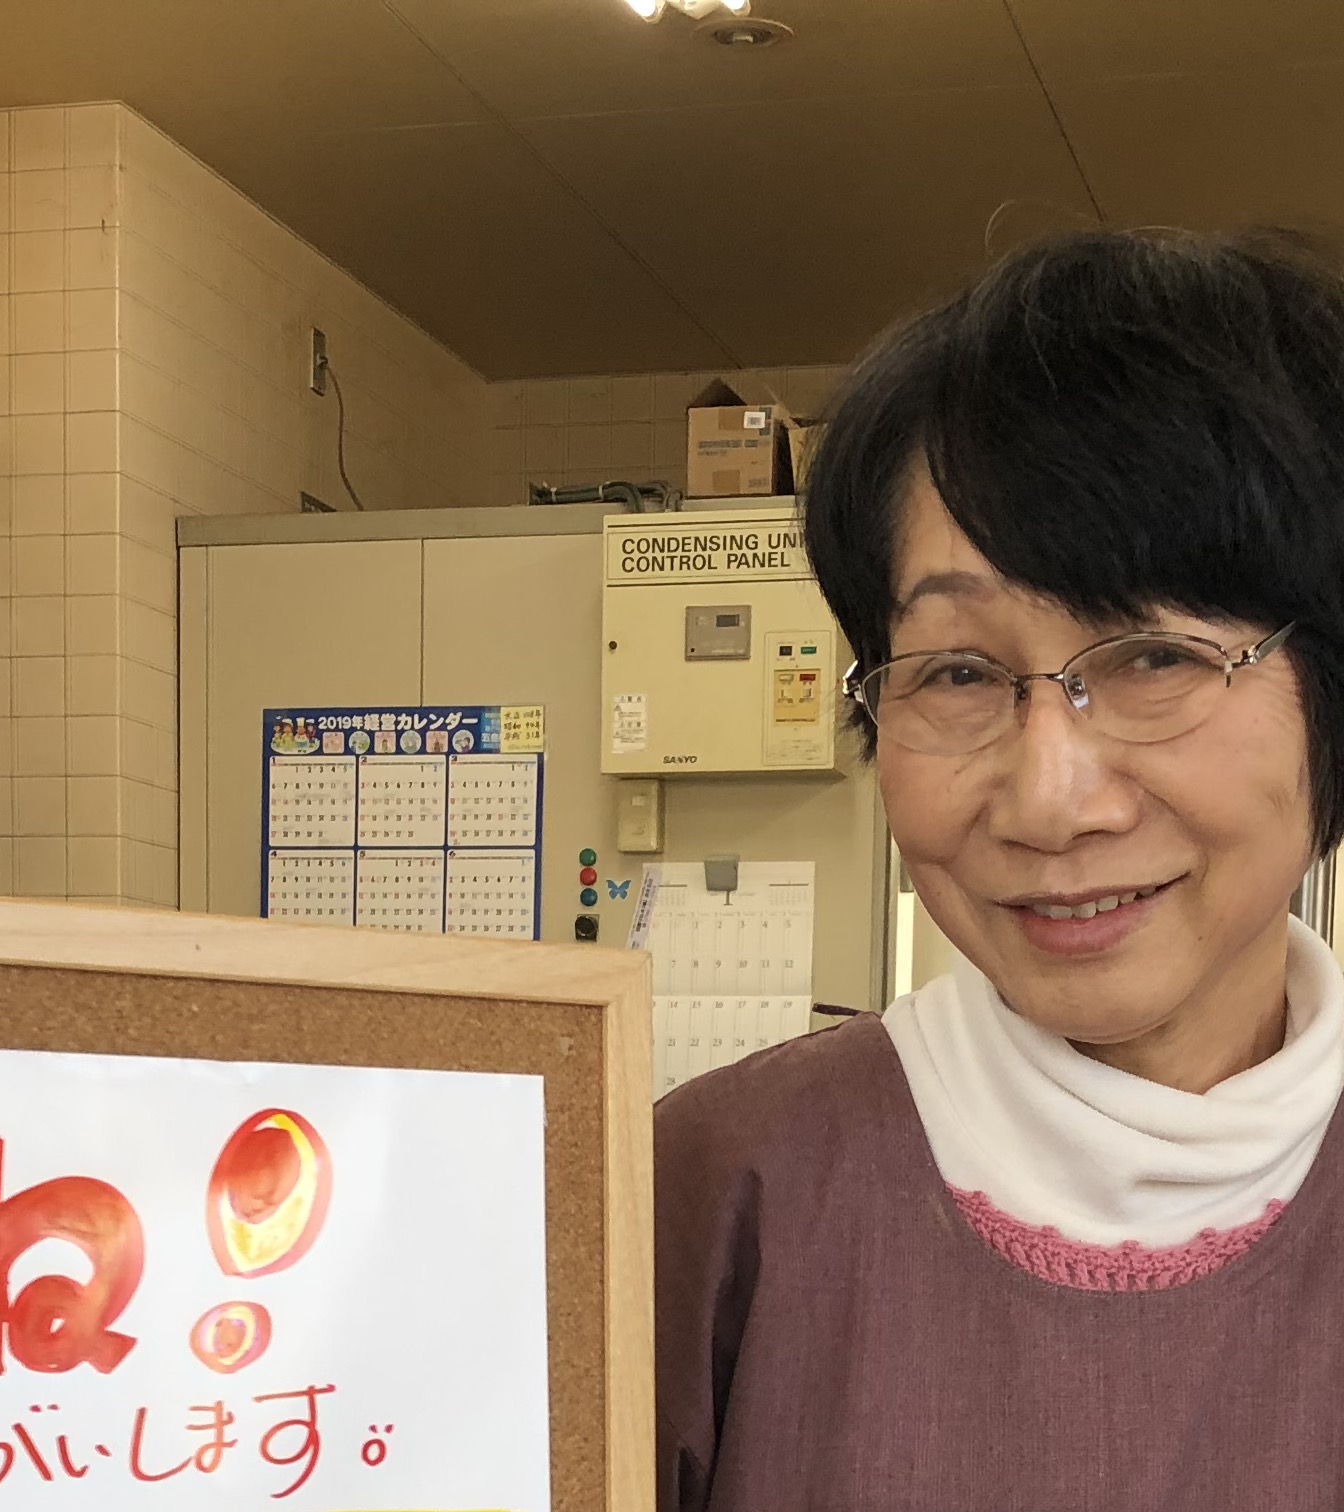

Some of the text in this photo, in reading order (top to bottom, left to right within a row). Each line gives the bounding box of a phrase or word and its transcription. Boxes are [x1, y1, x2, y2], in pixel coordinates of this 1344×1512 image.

[621, 532, 805, 555] CONDENSING UNI
[621, 551, 792, 573] CONTROL PANEL
[317, 711, 478, 732] 2019年経営カレンダー
[663, 755, 697, 764] SANYO
